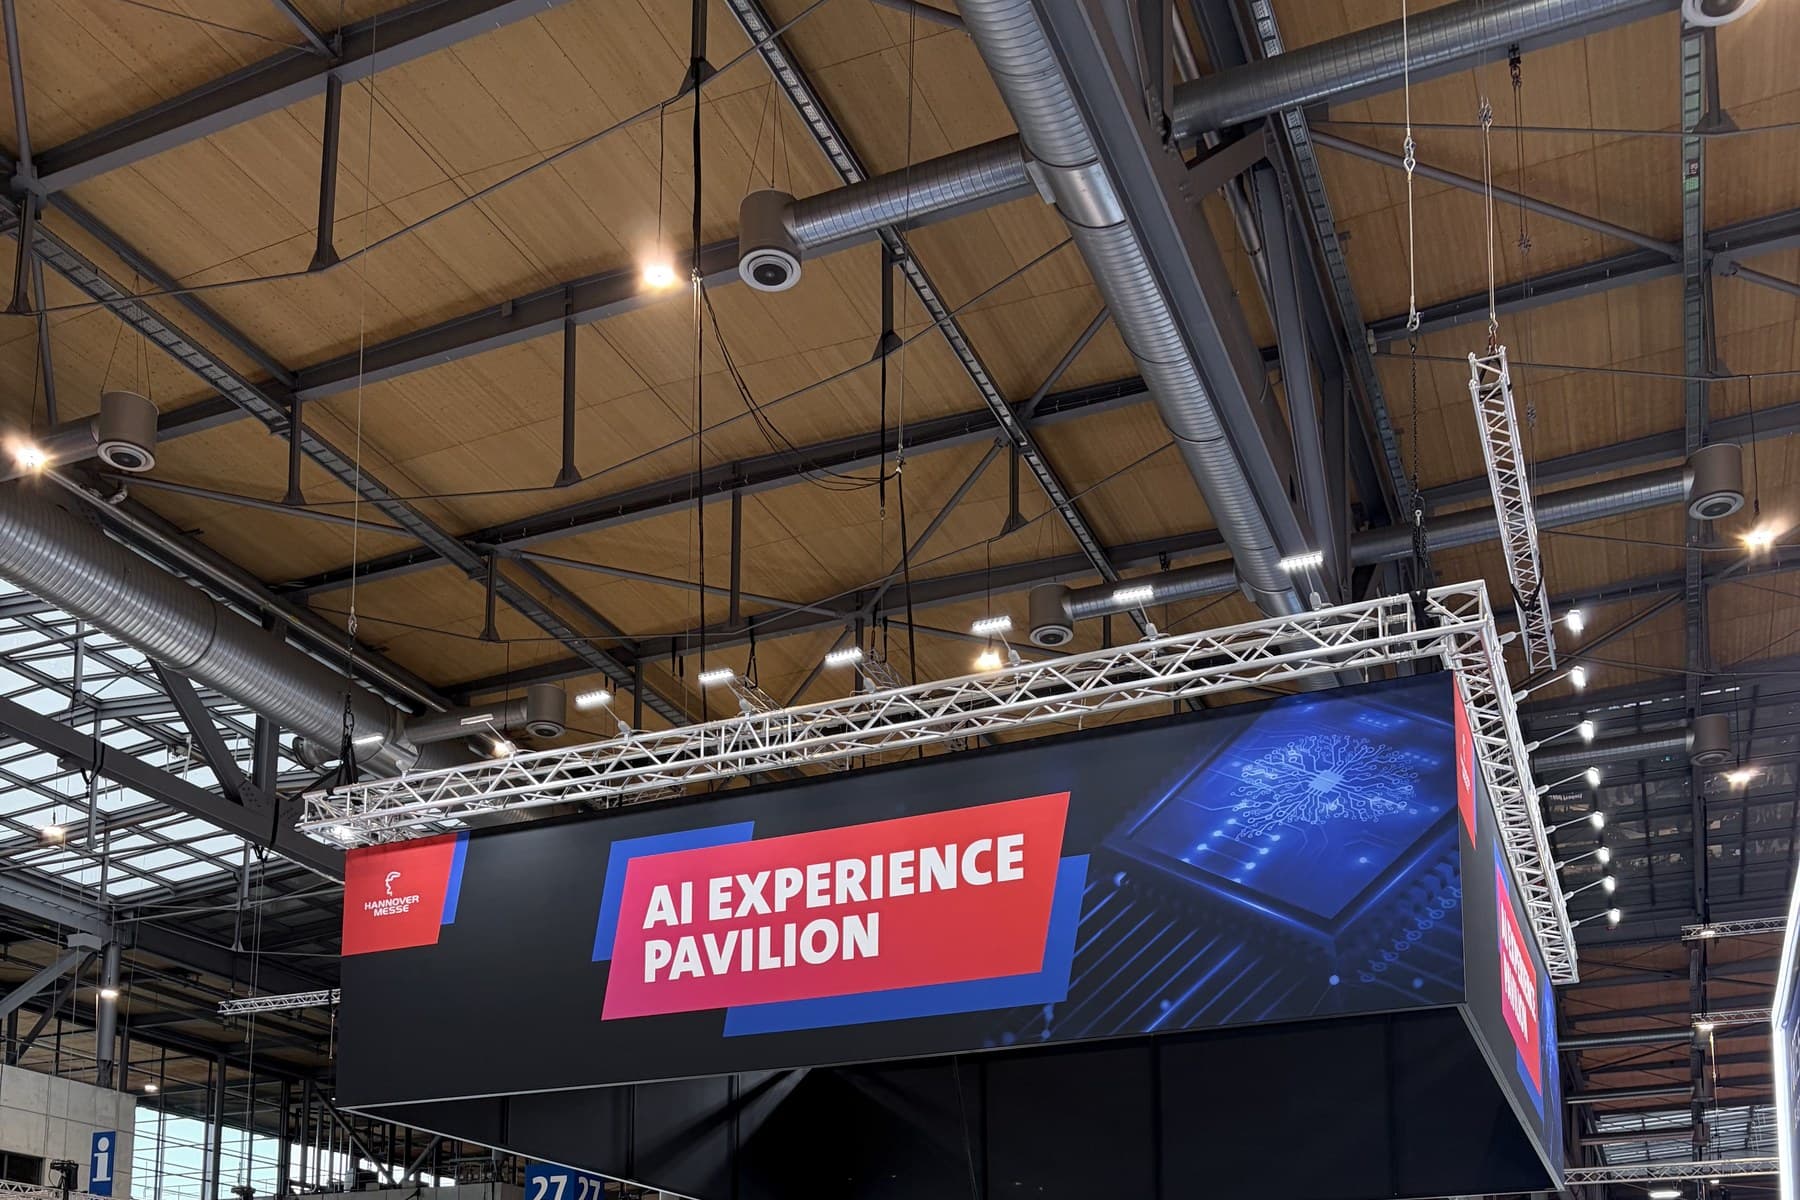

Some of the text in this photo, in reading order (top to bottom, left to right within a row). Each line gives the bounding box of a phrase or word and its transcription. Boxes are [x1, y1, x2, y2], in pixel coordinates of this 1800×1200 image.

[364, 895, 420, 911] HANNOVER
[642, 833, 1025, 929] AI EXPERIENCE
[373, 904, 409, 917] MESSE
[644, 911, 880, 984] PAVILION
